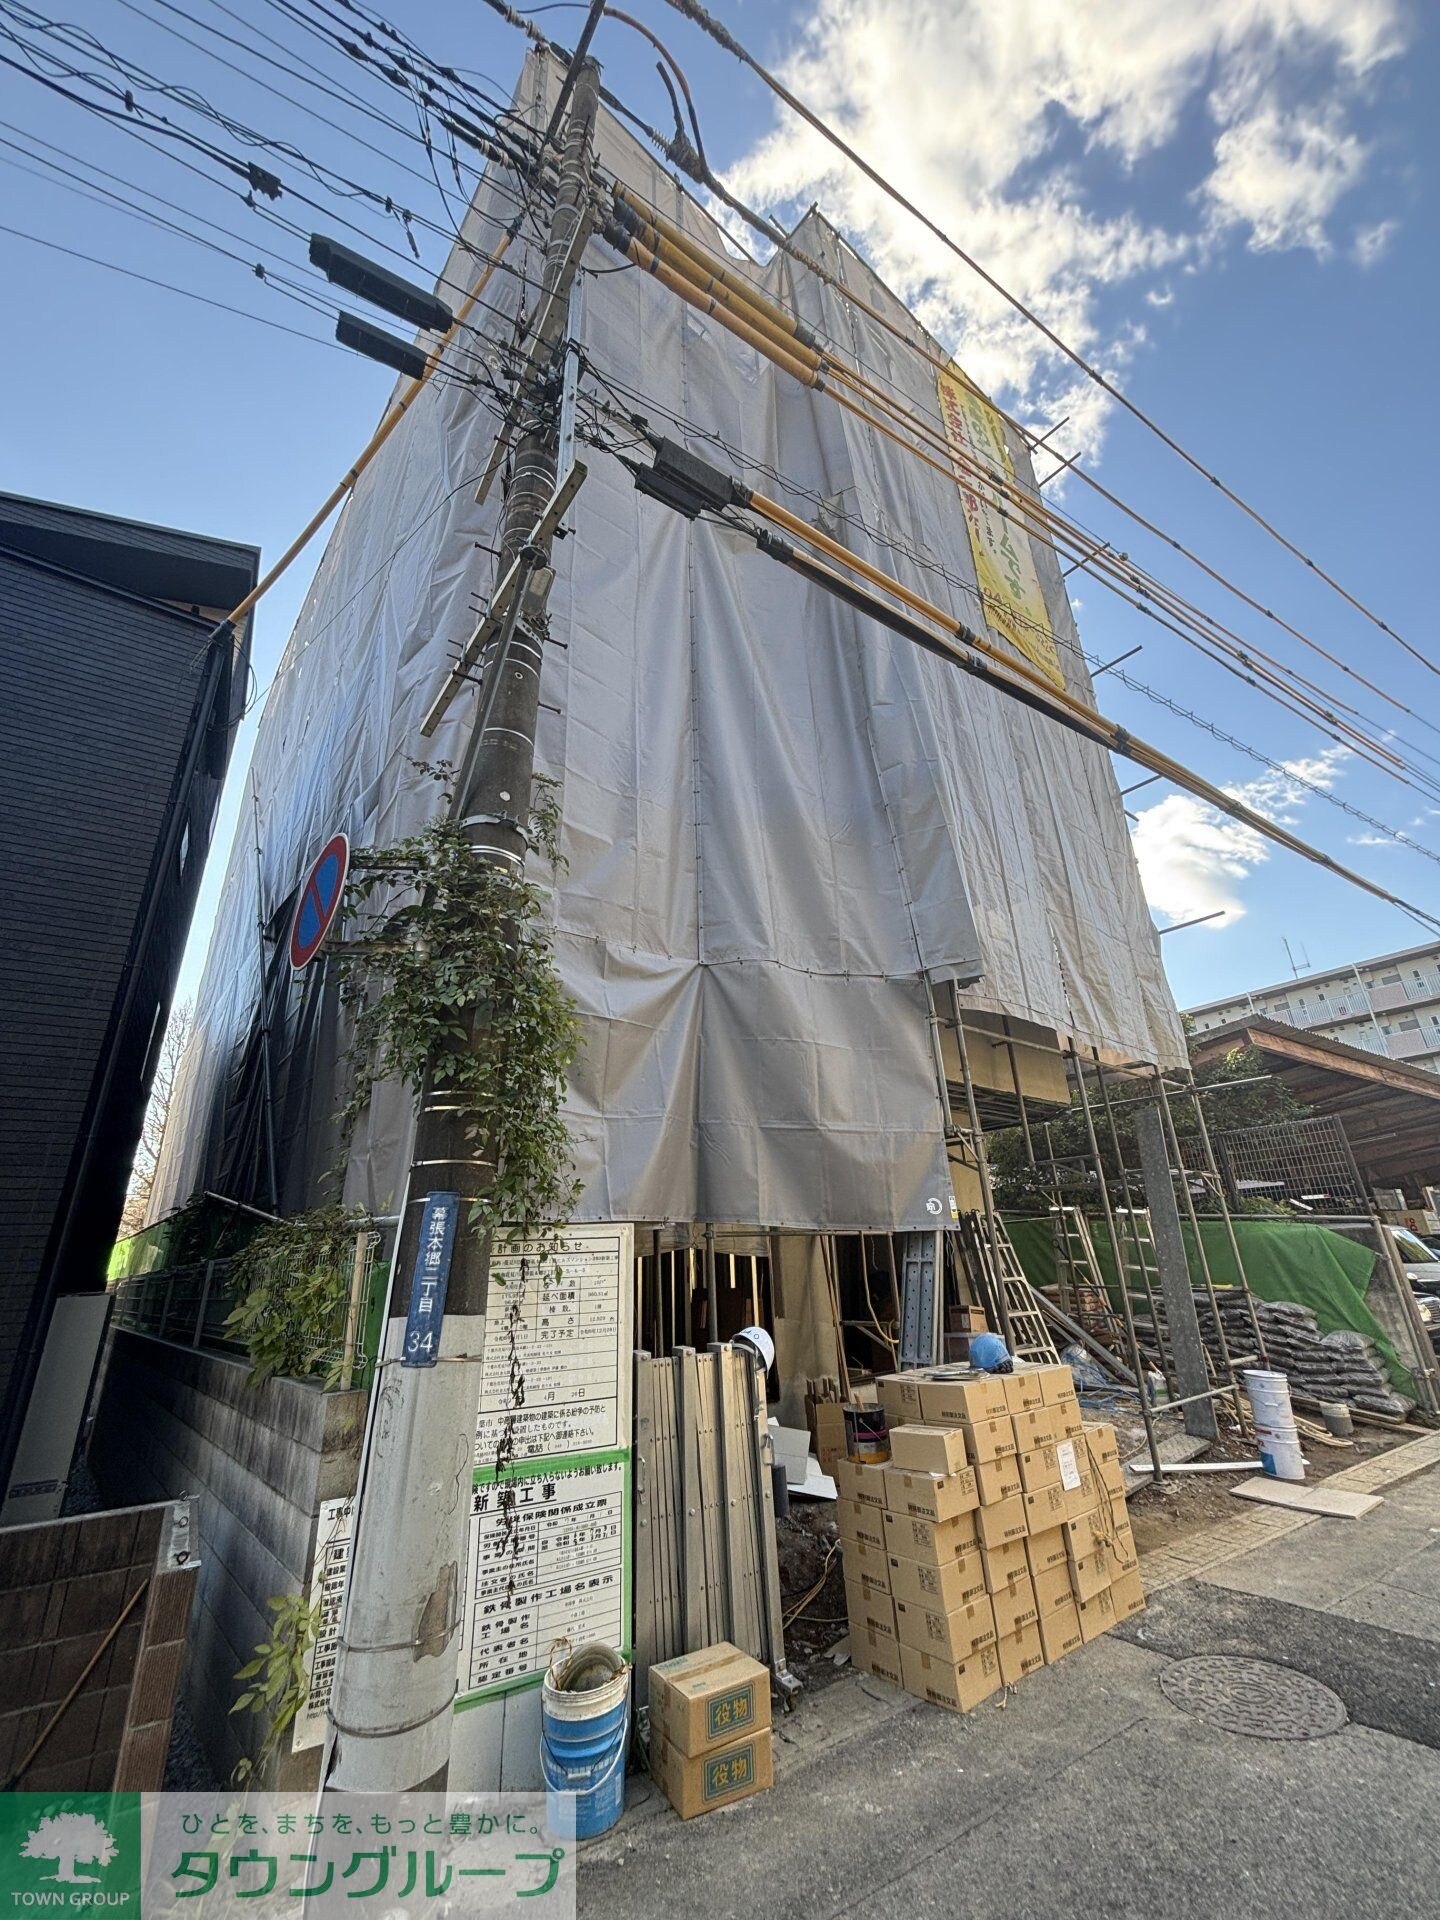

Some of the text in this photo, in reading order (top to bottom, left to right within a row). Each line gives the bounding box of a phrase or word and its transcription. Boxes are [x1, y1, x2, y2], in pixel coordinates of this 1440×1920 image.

[492, 1240, 583, 1254] 計画のお知らせ
[419, 1206, 448, 1313] 幕張本郷二丁目
[408, 1330, 433, 1353] 34
[541, 1329, 574, 1340] 完了予定
[473, 1483, 557, 1512] 新築工事
[483, 1575, 613, 1615] 鉄骨製作工場名表示
[481, 1613, 530, 1632] 鉄骨製作
[481, 1622, 529, 1640] 工場名
[479, 1651, 528, 1670] 所在地
[715, 1698, 748, 1725] 役物
[712, 1757, 747, 1787] 役物
